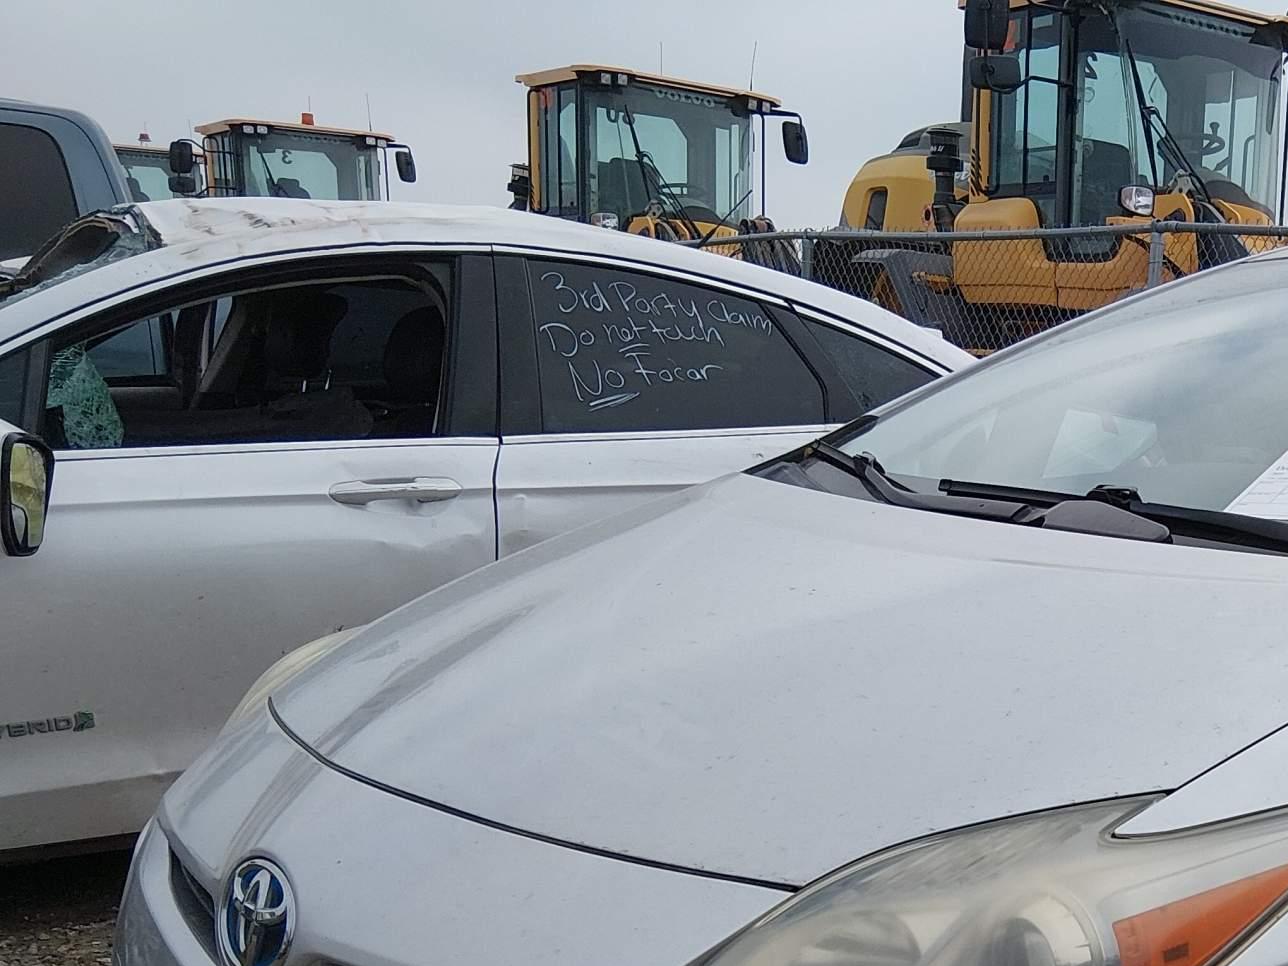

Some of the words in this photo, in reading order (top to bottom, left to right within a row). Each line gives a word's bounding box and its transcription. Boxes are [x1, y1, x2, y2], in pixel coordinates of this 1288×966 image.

[541, 271, 612, 313] 3rd
[608, 281, 703, 329] Party
[707, 299, 774, 336] Claim
[539, 322, 596, 357] Do
[568, 359, 626, 402] No
